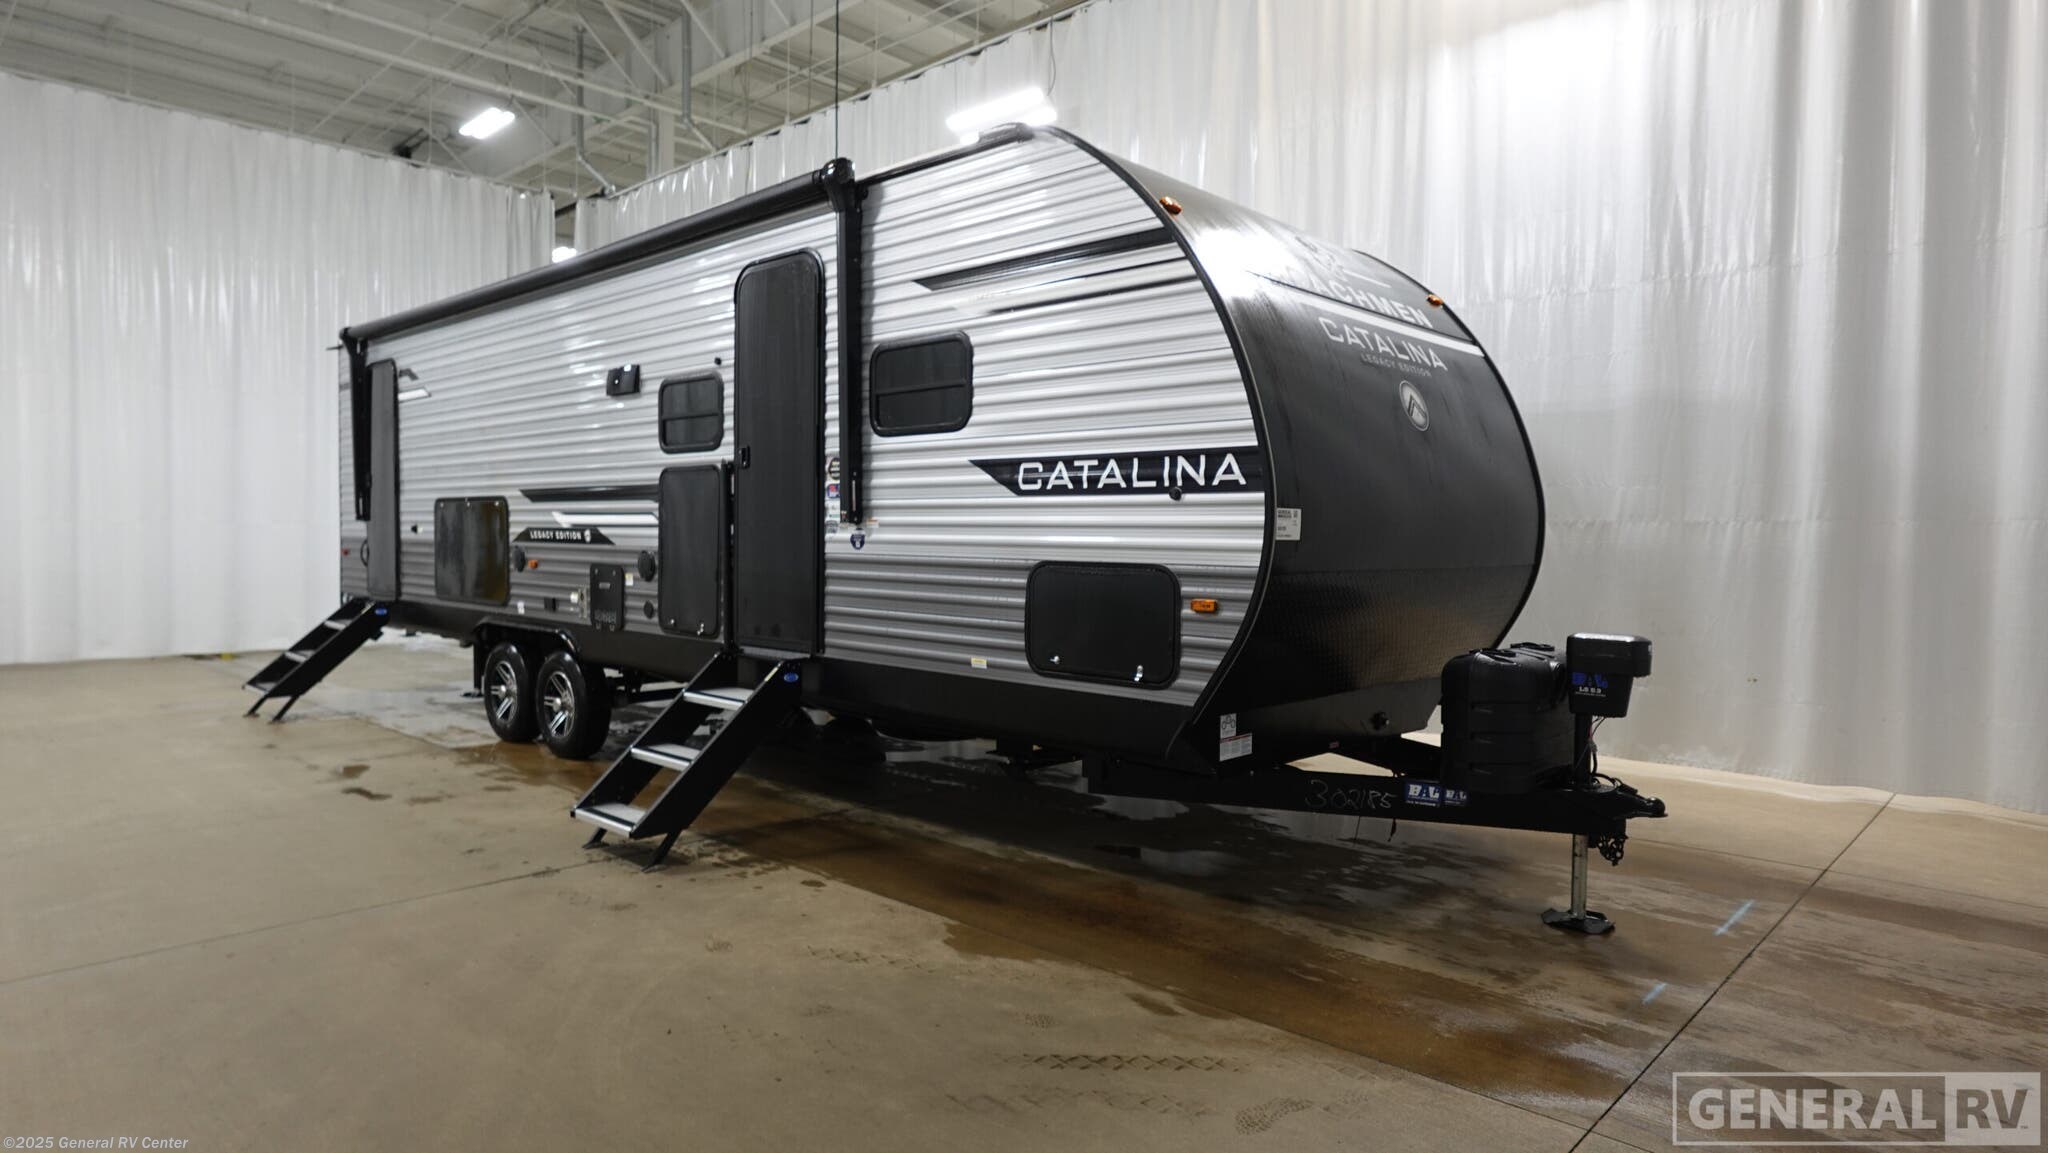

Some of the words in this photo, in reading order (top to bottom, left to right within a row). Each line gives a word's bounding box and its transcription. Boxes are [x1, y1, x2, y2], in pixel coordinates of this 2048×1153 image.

[1318, 316, 1448, 371] CATALINA
[1017, 453, 1247, 491] CATALINA
[530, 530, 553, 540] LEGACY
[555, 530, 582, 540] EDITION
